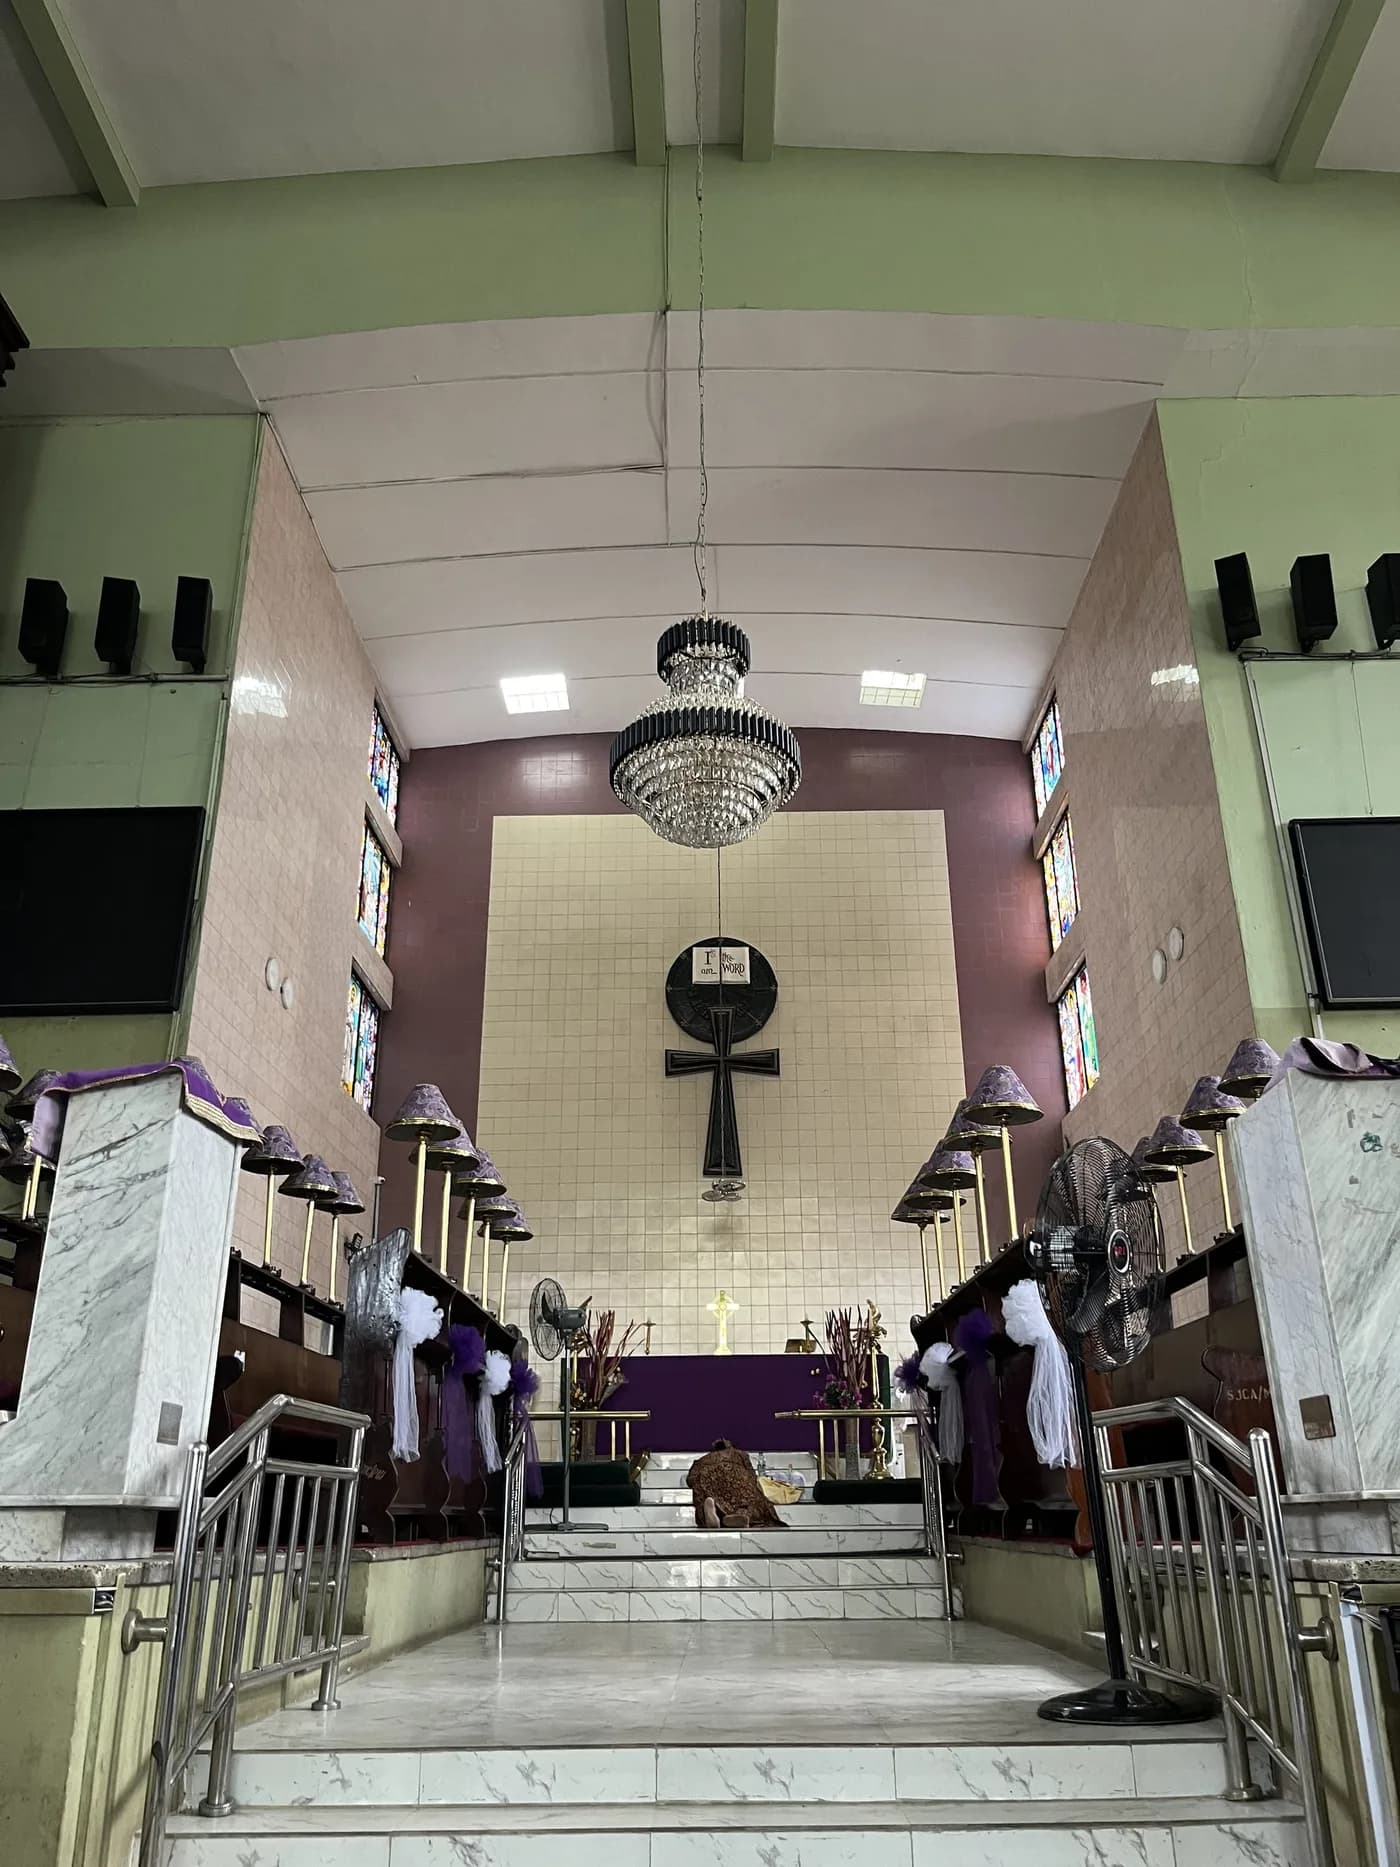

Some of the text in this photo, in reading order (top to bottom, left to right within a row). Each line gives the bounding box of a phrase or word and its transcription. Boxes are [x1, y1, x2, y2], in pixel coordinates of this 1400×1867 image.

[704, 951, 711, 965] I
[721, 952, 735, 963] the
[721, 963, 745, 977] WORD
